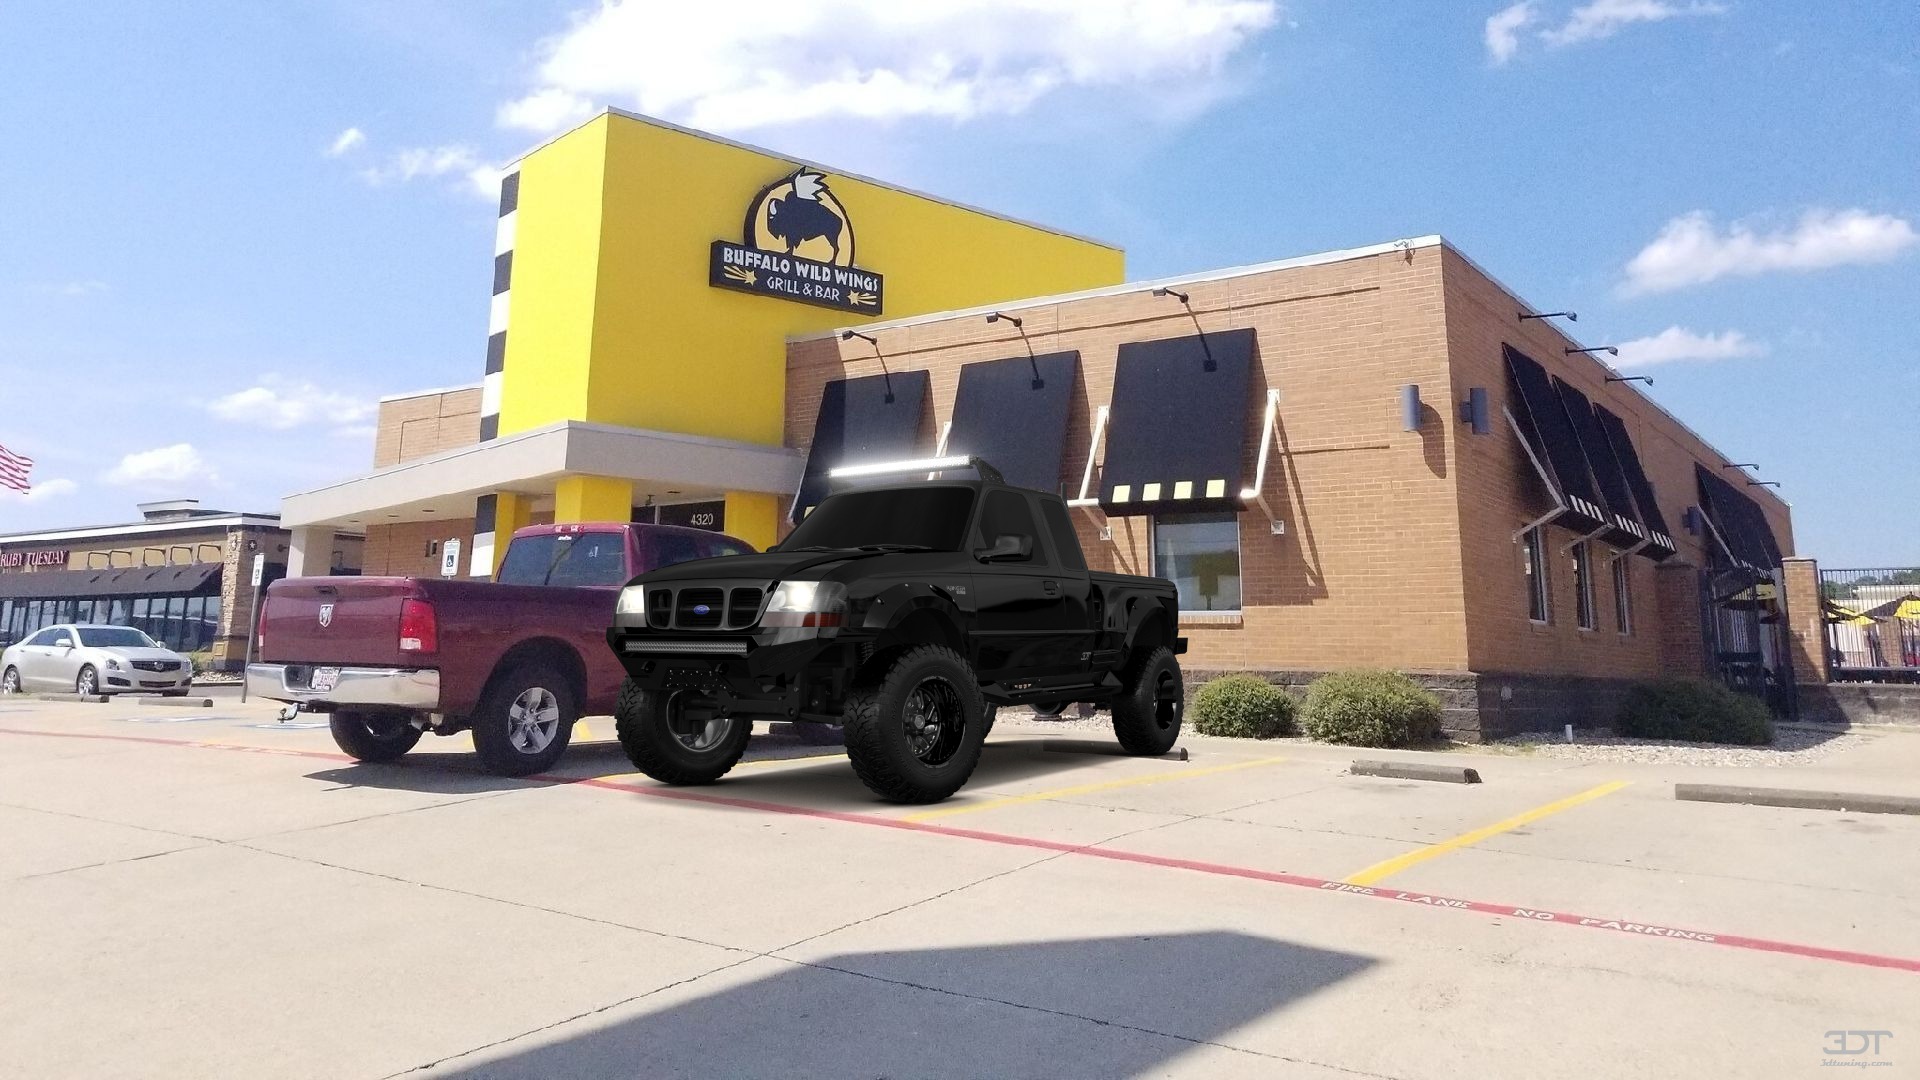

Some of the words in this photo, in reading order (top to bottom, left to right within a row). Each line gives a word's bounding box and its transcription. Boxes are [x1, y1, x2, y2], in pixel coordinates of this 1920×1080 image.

[723, 247, 791, 274] BUFFALO
[795, 261, 831, 282] WILD
[834, 269, 878, 292] WINGS
[766, 276, 800, 295] GRILL
[802, 282, 813, 297] &
[814, 285, 840, 302] BAR
[690, 513, 714, 526] 4320
[0, 553, 22, 566] RUBY
[27, 550, 65, 565] TUESDAY
[1320, 882, 1375, 895] FIRE
[1396, 893, 1471, 908] LANE
[1513, 909, 1555, 920] NO
[1579, 918, 1715, 942] PARKING
